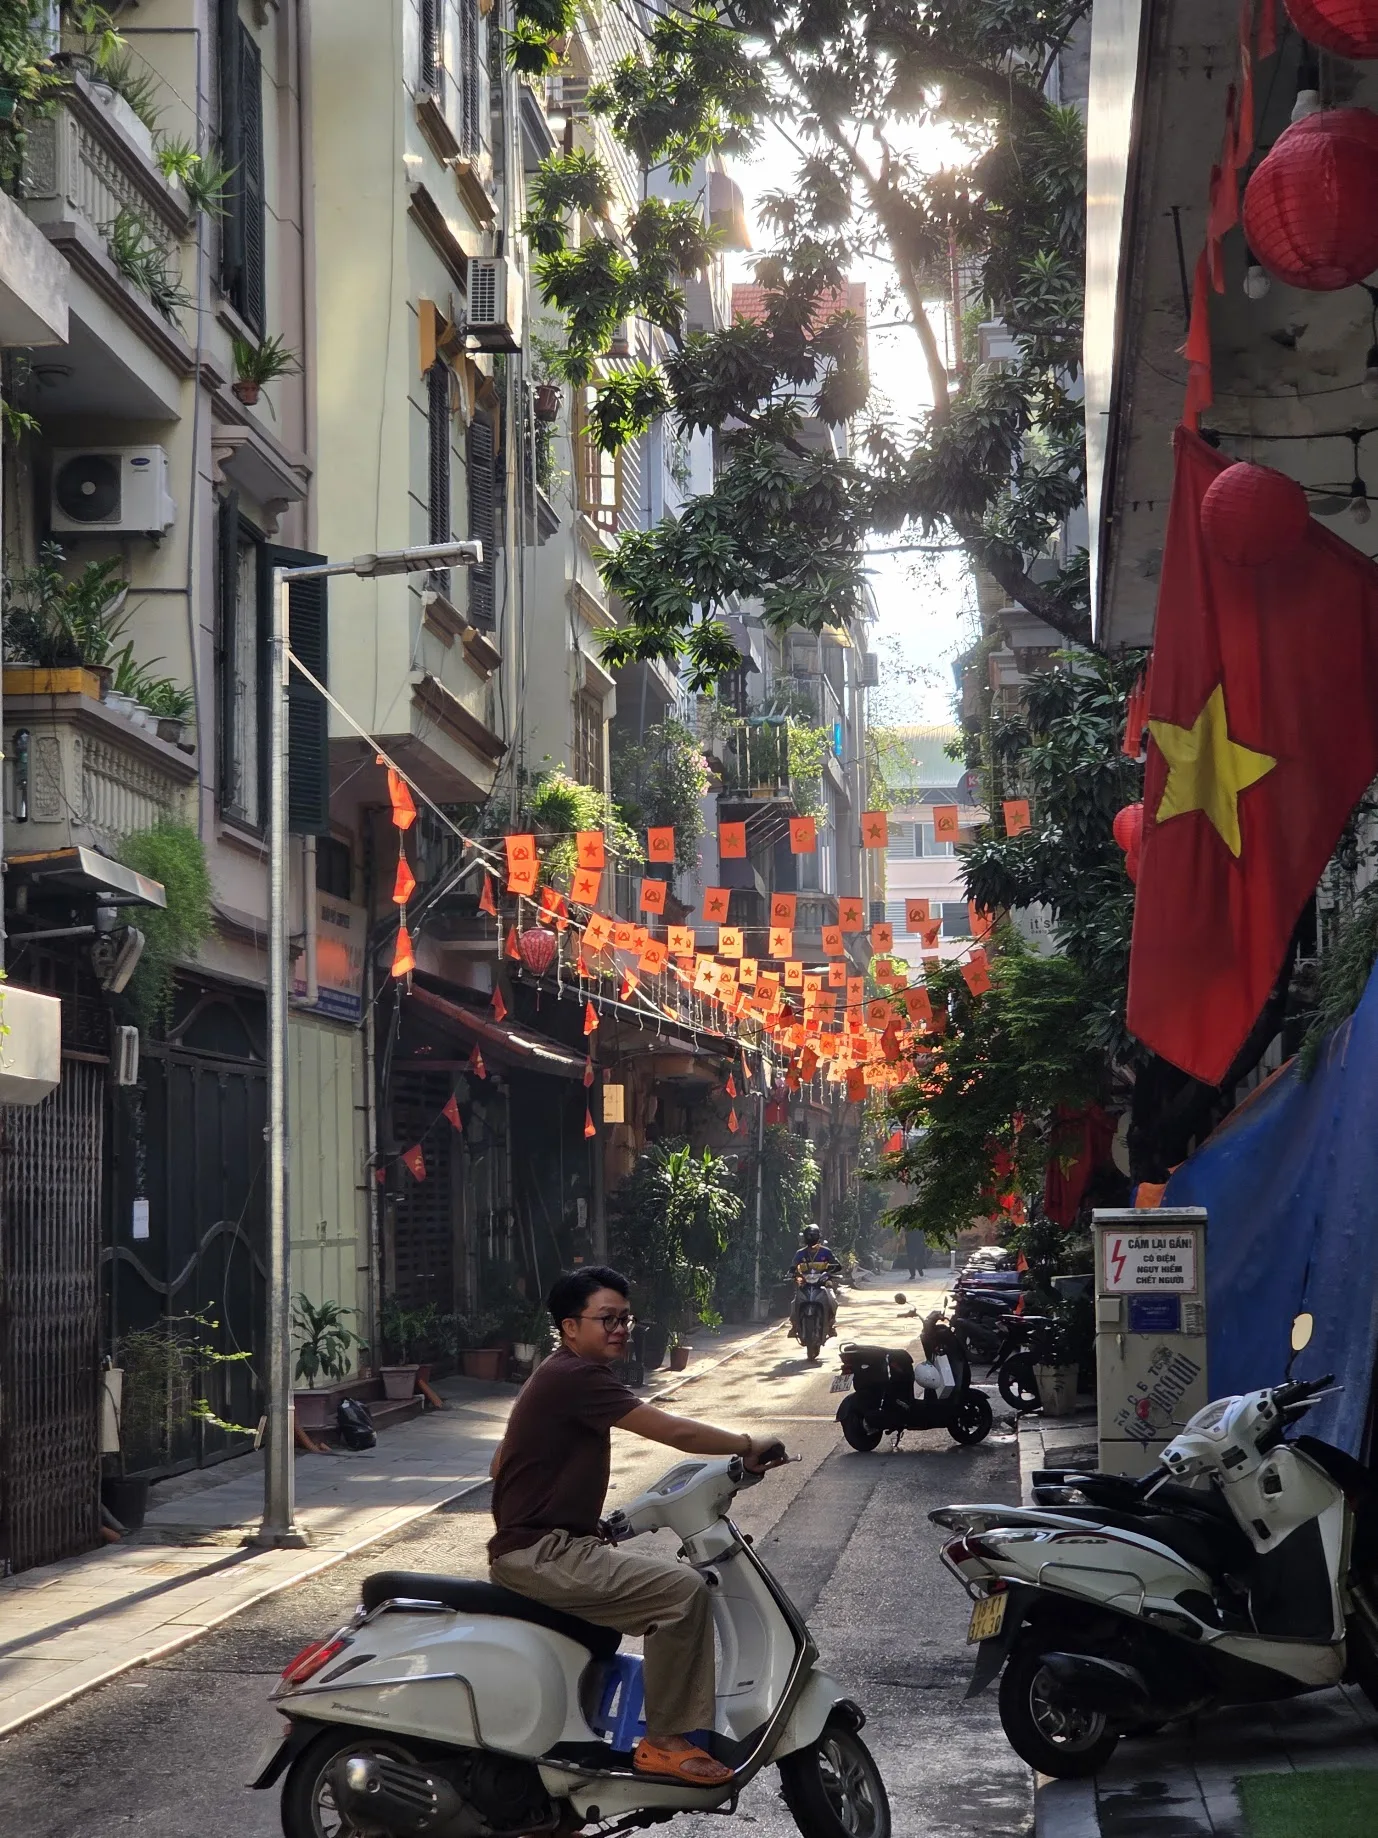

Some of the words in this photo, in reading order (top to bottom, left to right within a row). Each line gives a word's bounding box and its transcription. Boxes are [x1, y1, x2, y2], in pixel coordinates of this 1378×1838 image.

[1030, 917, 1051, 929] it's
[1128, 1236, 1149, 1249] CẤM
[1151, 1239, 1167, 1251] LẠI
[1143, 1254, 1155, 1263] CÓ
[1137, 1265, 1159, 1273] NGUY
